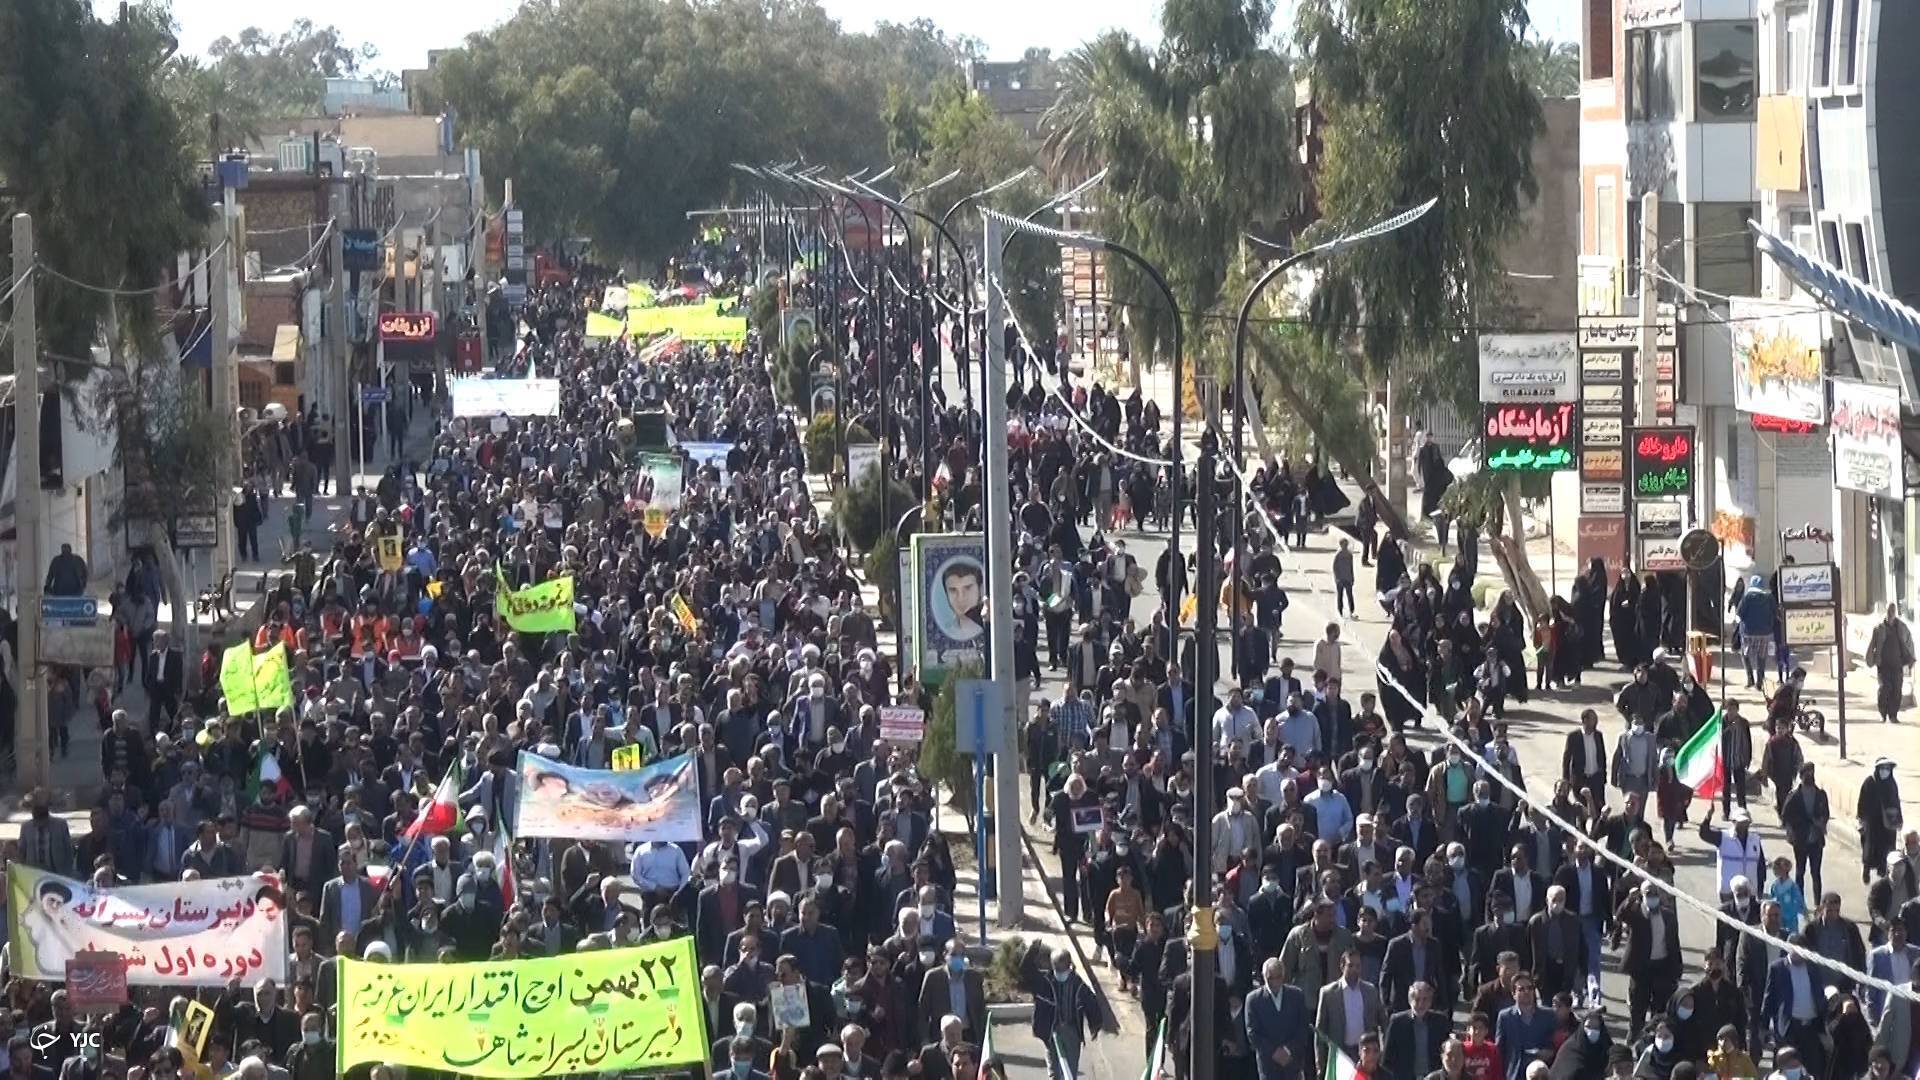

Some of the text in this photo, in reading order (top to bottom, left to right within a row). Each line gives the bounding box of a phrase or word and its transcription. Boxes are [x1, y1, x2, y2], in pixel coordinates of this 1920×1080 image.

[1487, 405, 1571, 445] آزمایشگاه
[1533, 449, 1571, 469] دکتر
[72, 896, 256, 931] دبیرستان پسرانه
[153, 944, 196, 976] اول
[203, 947, 263, 978] دوره
[640, 954, 677, 990] ۲۲
[397, 975, 454, 1018] ایران
[453, 970, 519, 1014] اقتدار
[521, 971, 563, 1014] اوج
[570, 968, 640, 1007] بهمن
[528, 1028, 588, 1076] پسرانه
[583, 1020, 683, 1066] دبیرستان
